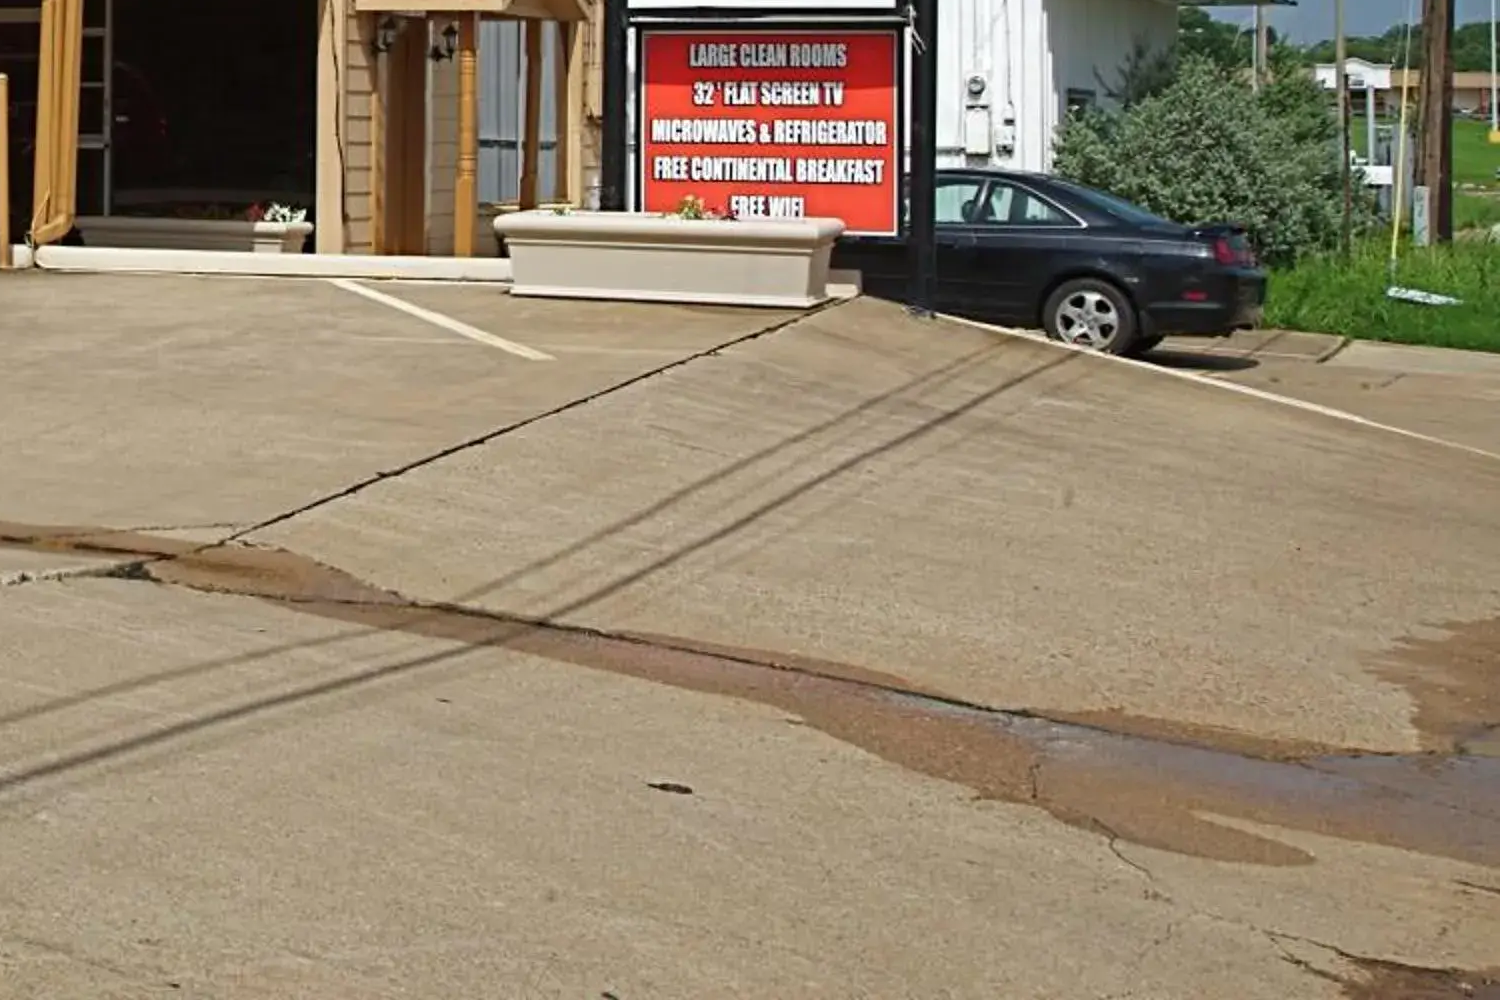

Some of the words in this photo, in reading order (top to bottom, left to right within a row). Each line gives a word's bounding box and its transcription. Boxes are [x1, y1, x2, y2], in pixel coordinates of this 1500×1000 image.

[689, 43, 737, 67] LARGE
[739, 43, 787, 67] CLEAN
[789, 43, 847, 67] ROOMS
[723, 82, 758, 105] FLAT
[760, 82, 820, 105] SCREEN
[822, 81, 844, 105] TV
[652, 119, 757, 143] MICROWAVES
[759, 122, 771, 143] &
[773, 119, 887, 145] REFRIGERATOR
[654, 156, 690, 180] FREE
[691, 157, 793, 182] CONTINENTAL
[795, 158, 885, 184] BREAKFAST
